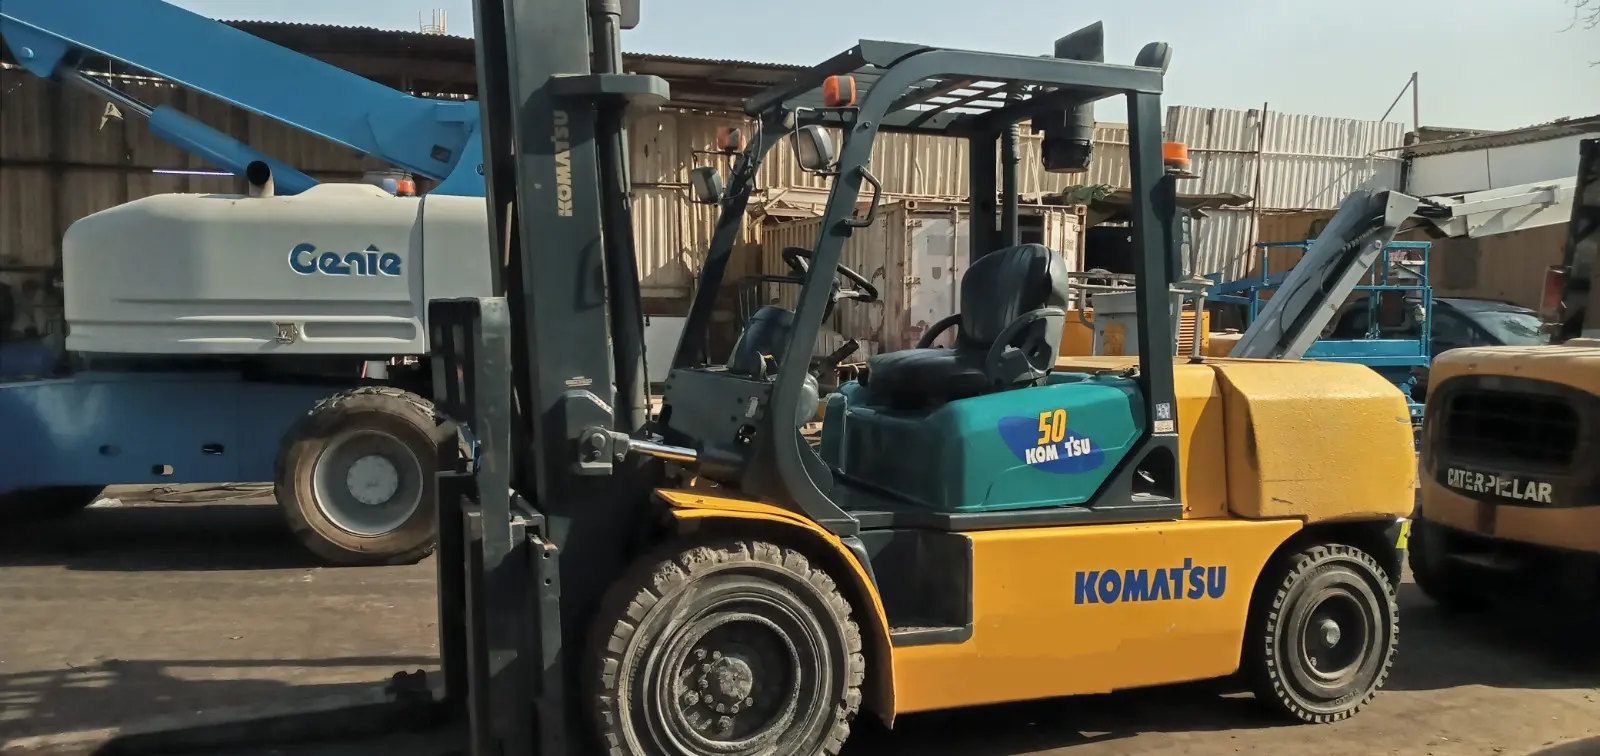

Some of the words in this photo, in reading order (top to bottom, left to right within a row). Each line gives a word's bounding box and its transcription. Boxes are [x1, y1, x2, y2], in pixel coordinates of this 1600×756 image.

[551, 110, 573, 217] KOMATSU
[288, 243, 402, 276] Genie
[1037, 408, 1067, 446] 50
[1025, 436, 1091, 465] KOMTSU
[1074, 557, 1227, 605] KOMATSU
